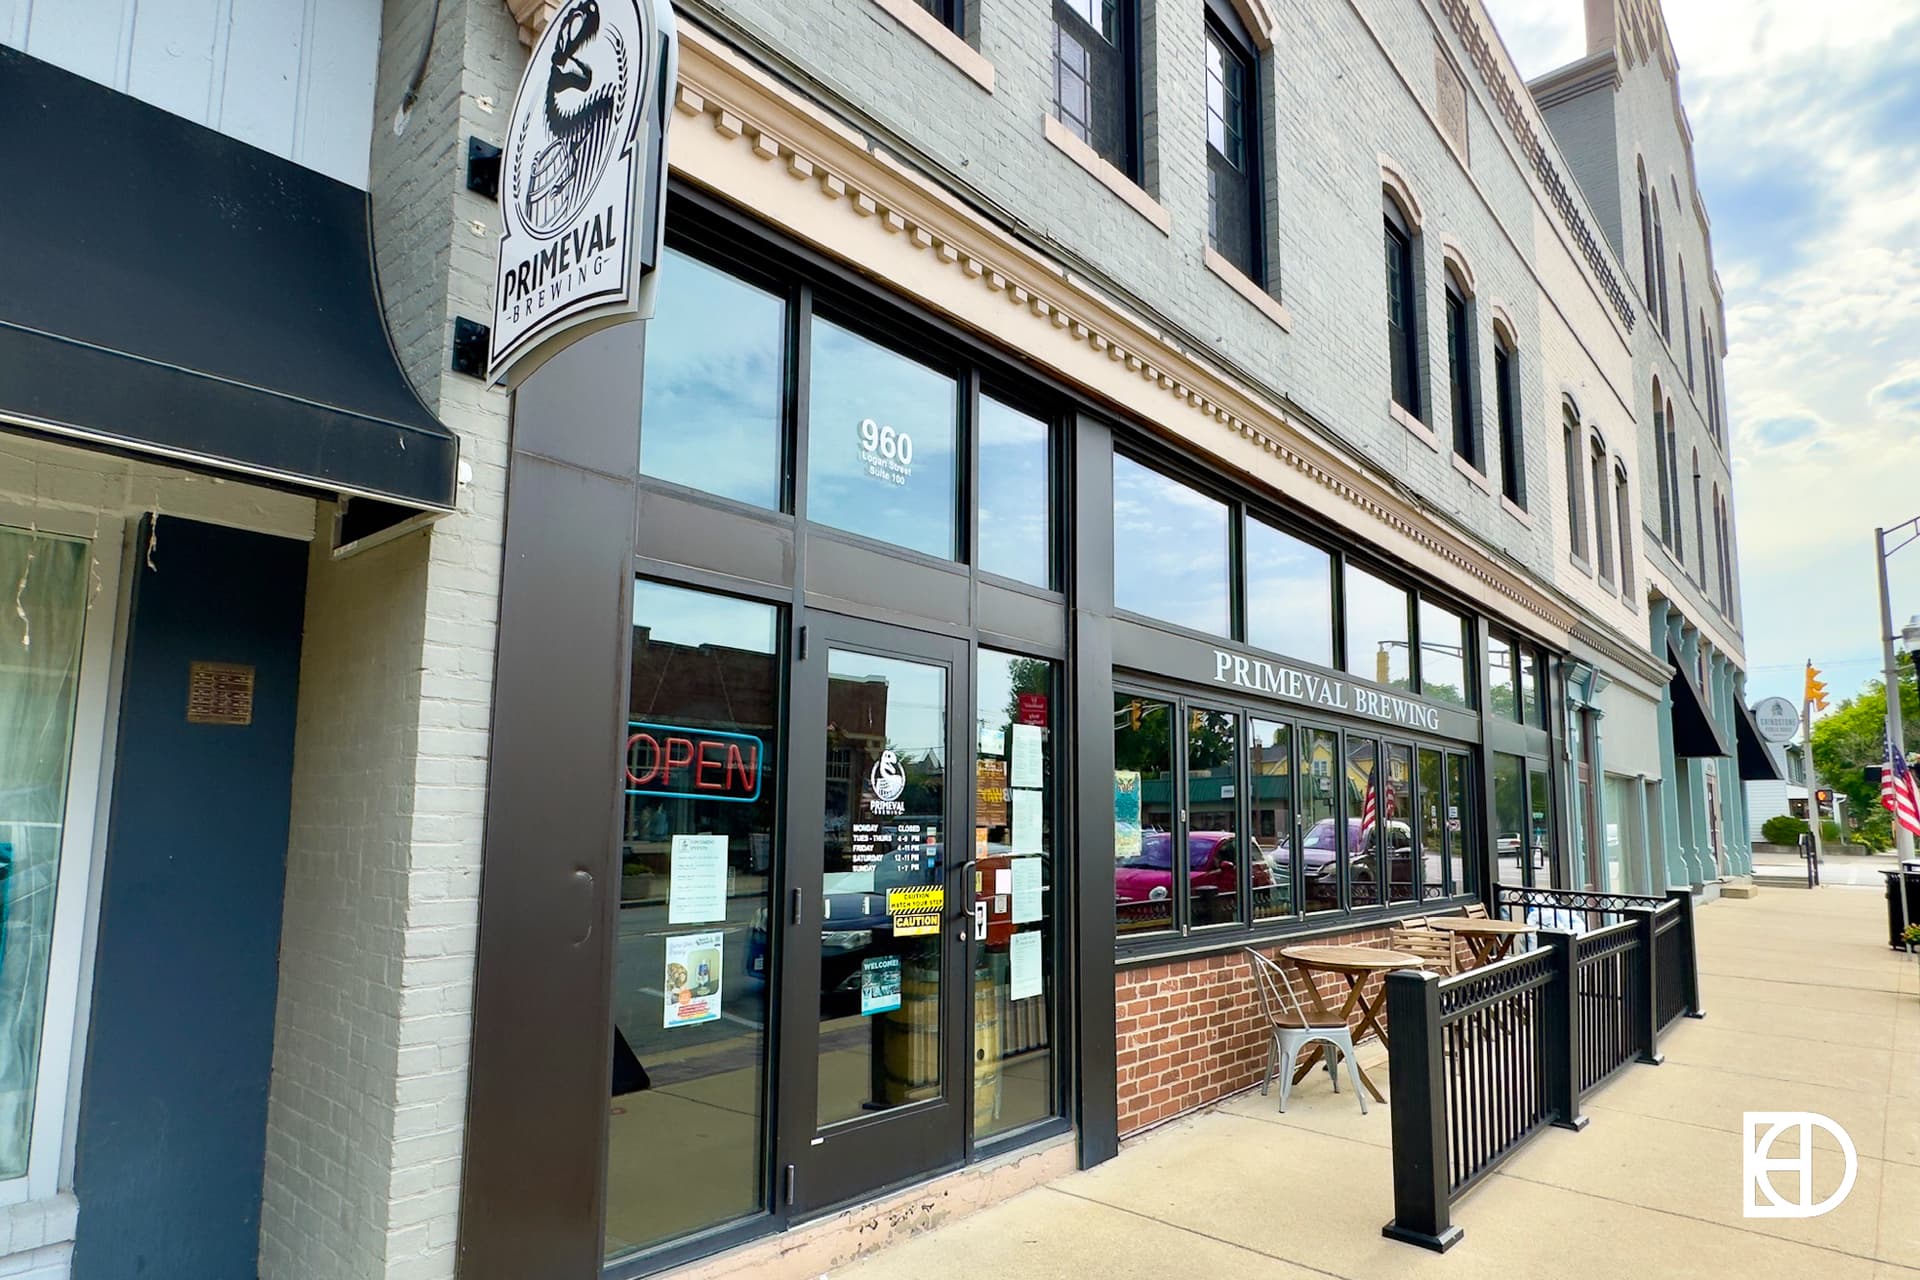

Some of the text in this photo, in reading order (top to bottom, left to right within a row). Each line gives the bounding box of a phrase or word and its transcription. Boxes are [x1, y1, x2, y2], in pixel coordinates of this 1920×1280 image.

[503, 205, 616, 312] PRIMEVAL
[862, 418, 912, 464] 960
[862, 450, 888, 467] Logan
[869, 465, 905, 485] Suite 100
[1213, 650, 1439, 730] PRIMEVAL BREWING
[625, 733, 757, 792] OPEN
[870, 800, 906, 812] PRIMEVAL
[853, 824, 921, 832] MONDAY CLOSED
[852, 844, 875, 852] FRIDAY
[852, 854, 884, 862] SATURDAY
[896, 916, 938, 927] CAUTION
